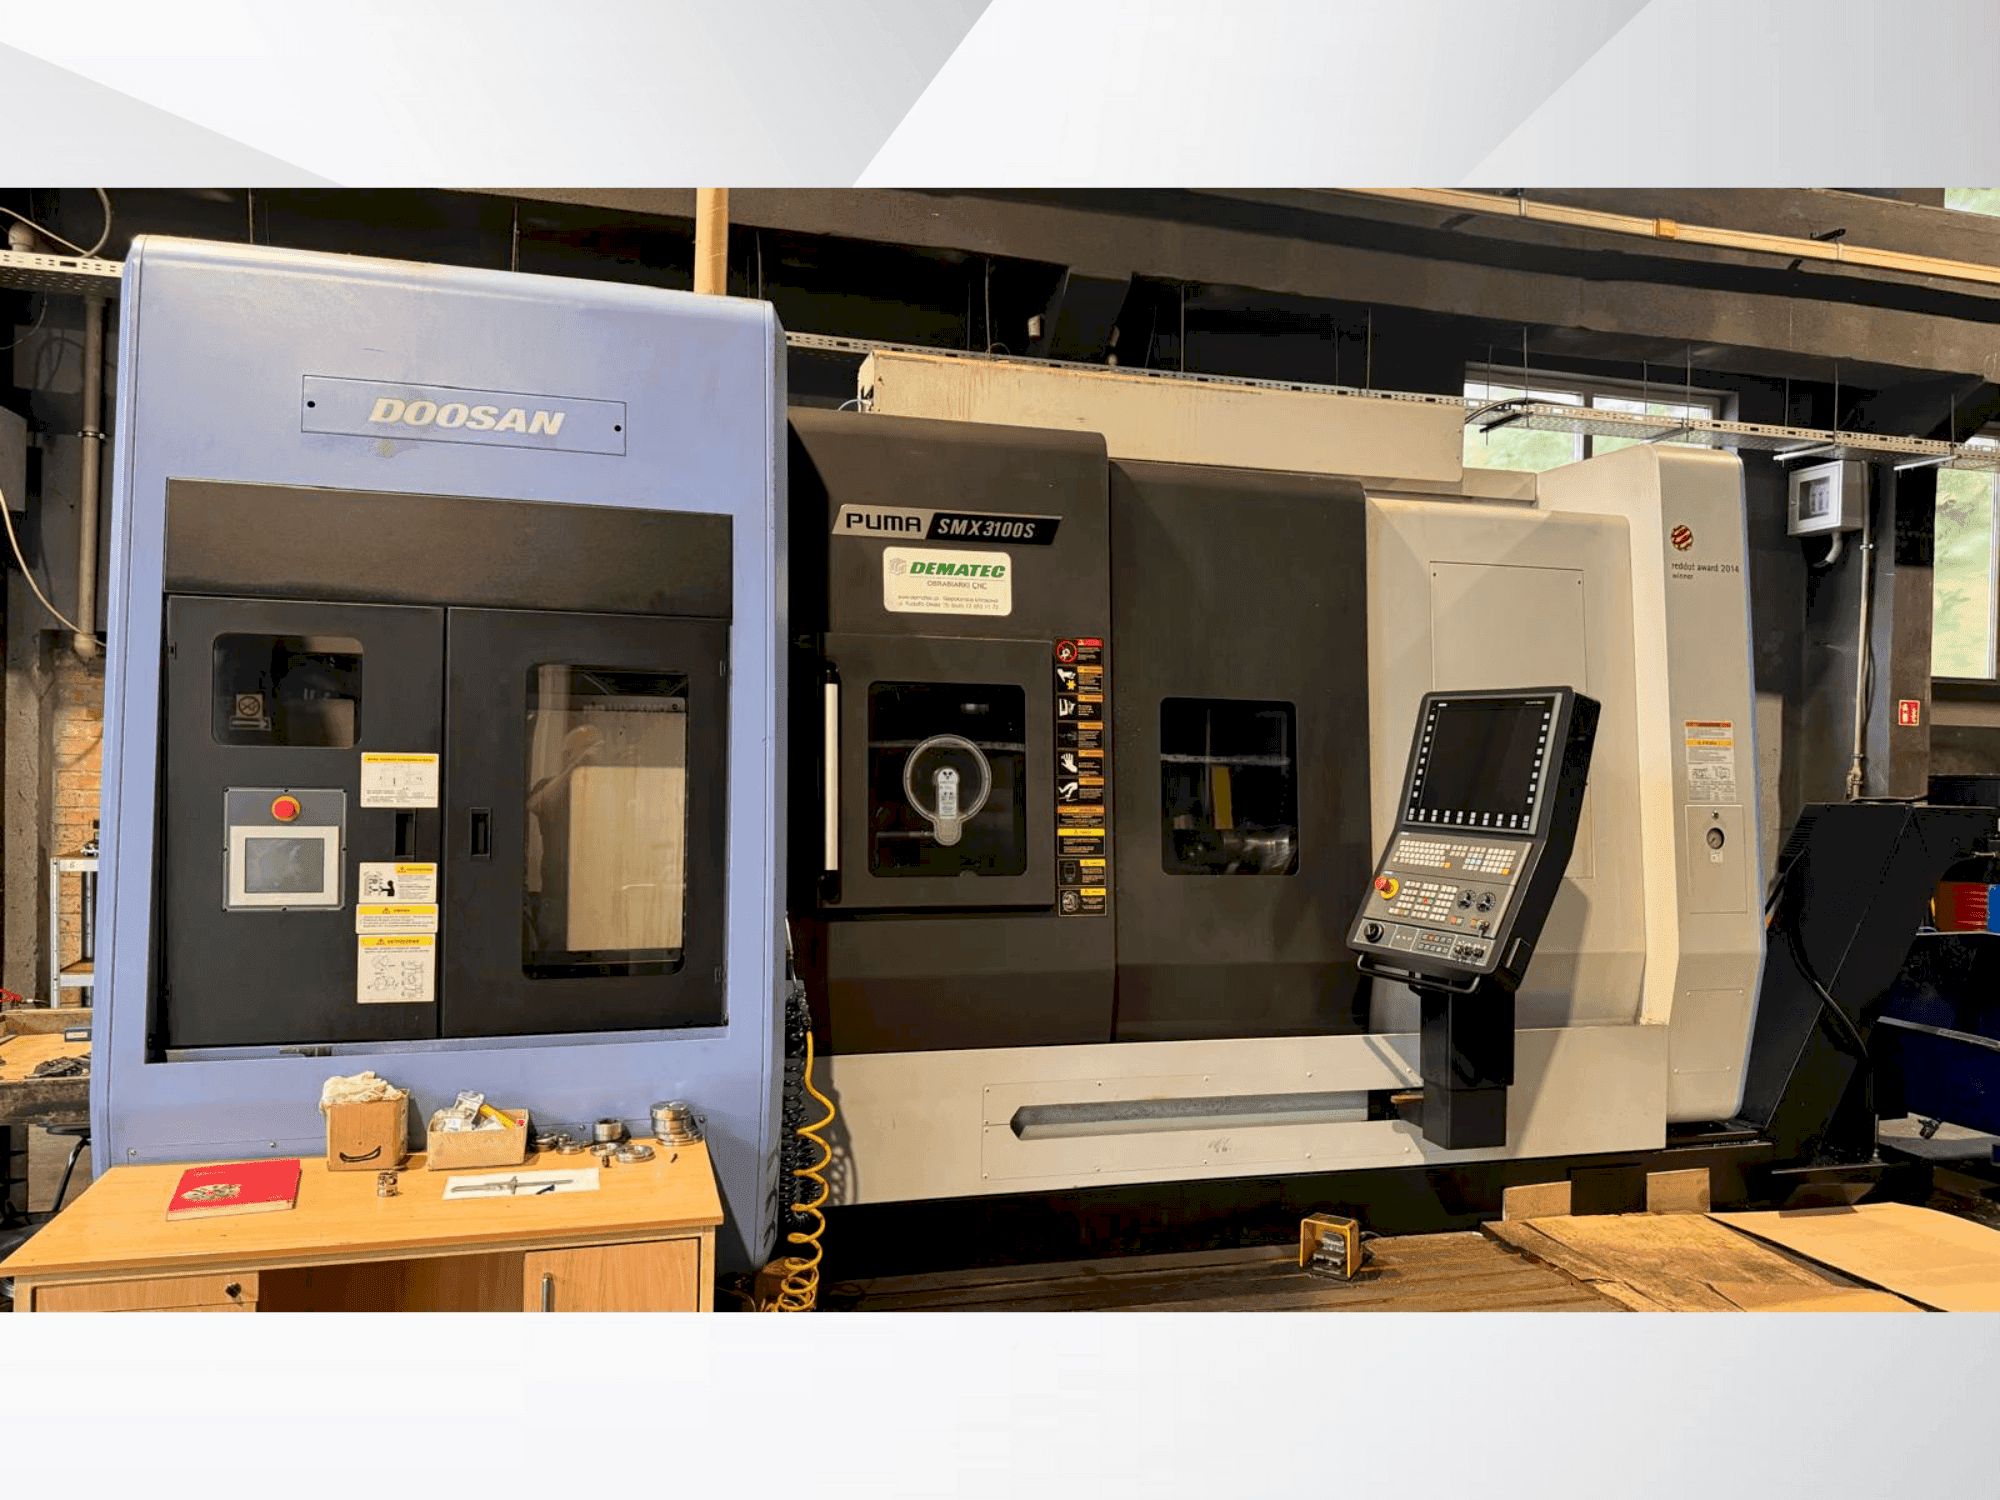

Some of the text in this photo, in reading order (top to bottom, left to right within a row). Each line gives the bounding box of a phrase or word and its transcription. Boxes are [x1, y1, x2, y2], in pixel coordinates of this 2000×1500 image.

[369, 398, 565, 435] DOOSAN
[845, 512, 1037, 539] PUMA SMX3100S
[909, 561, 1006, 578] DEMATEC
[1697, 563, 1719, 572] award
[1720, 564, 1740, 574] 2014
